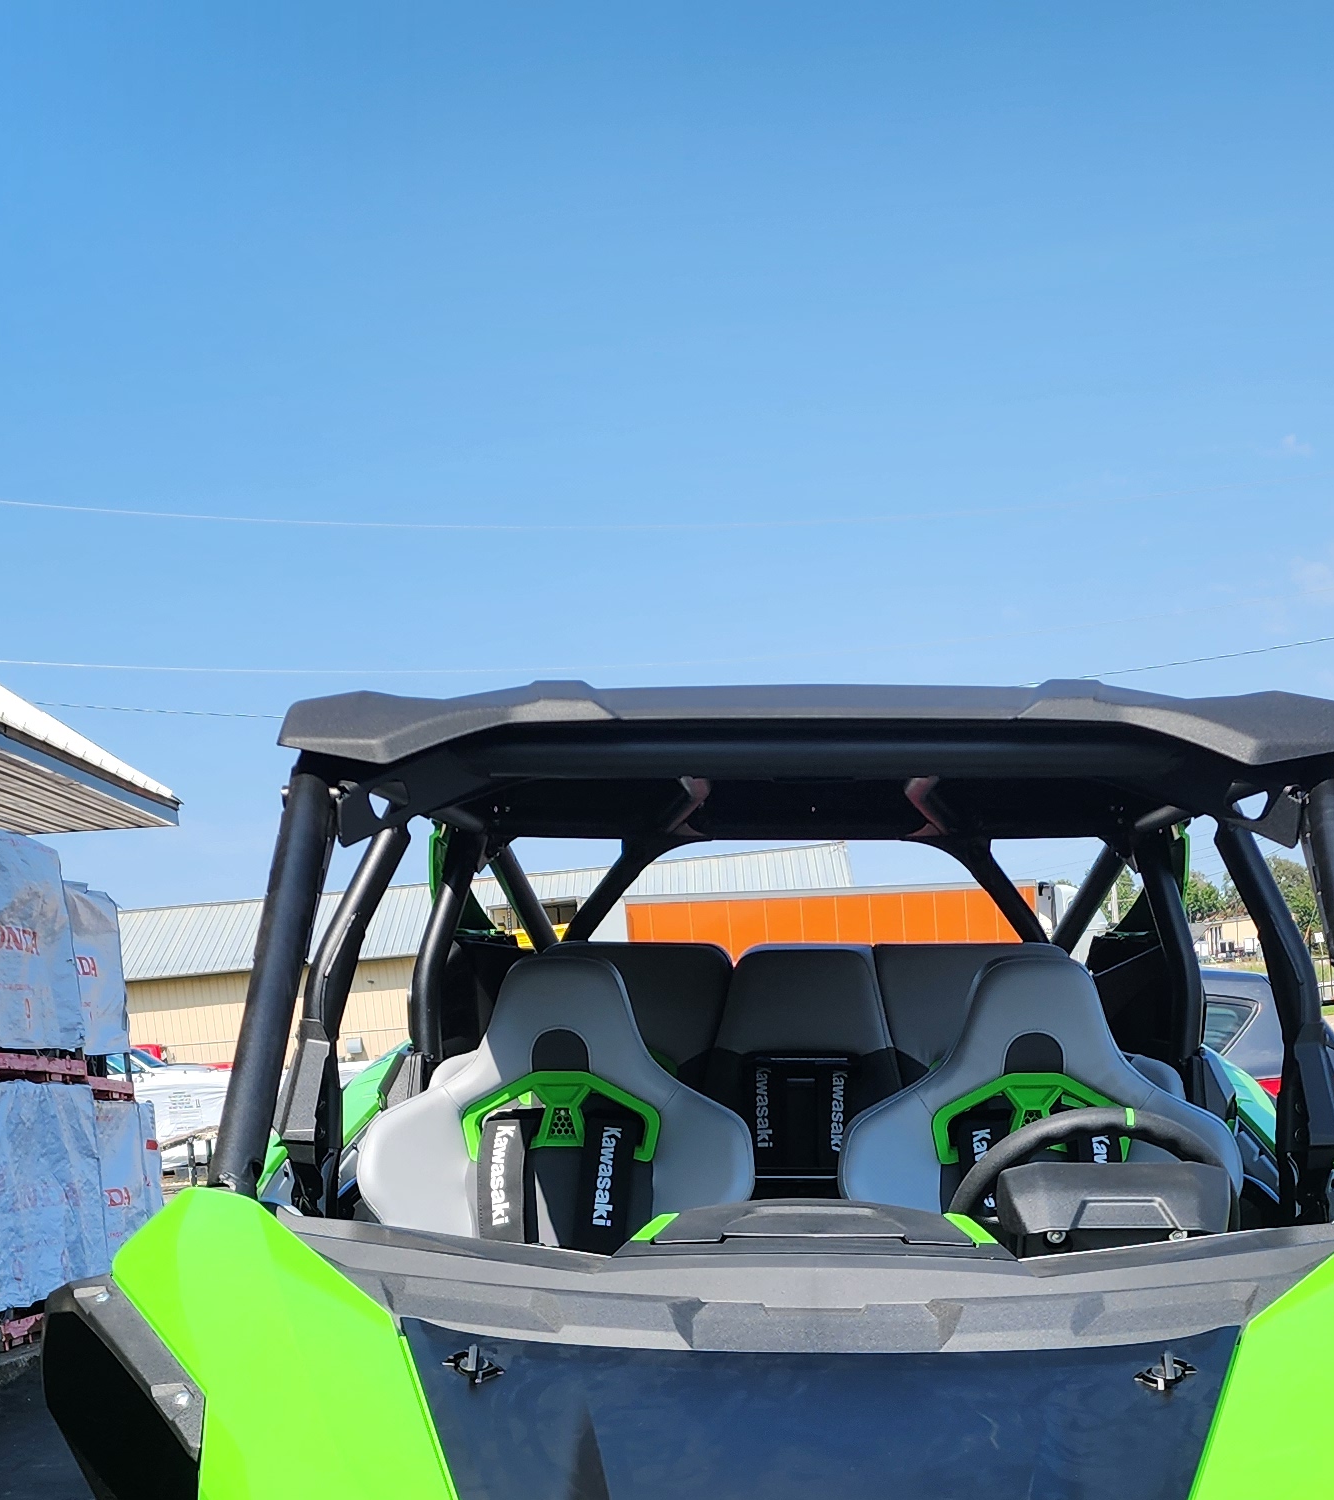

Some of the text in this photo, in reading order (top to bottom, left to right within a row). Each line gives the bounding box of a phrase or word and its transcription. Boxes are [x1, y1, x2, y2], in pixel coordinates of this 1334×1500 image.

[756, 1066, 773, 1148] Kawasaki
[490, 1125, 517, 1226] Kawasaki
[592, 1126, 622, 1227] Kawasaki
